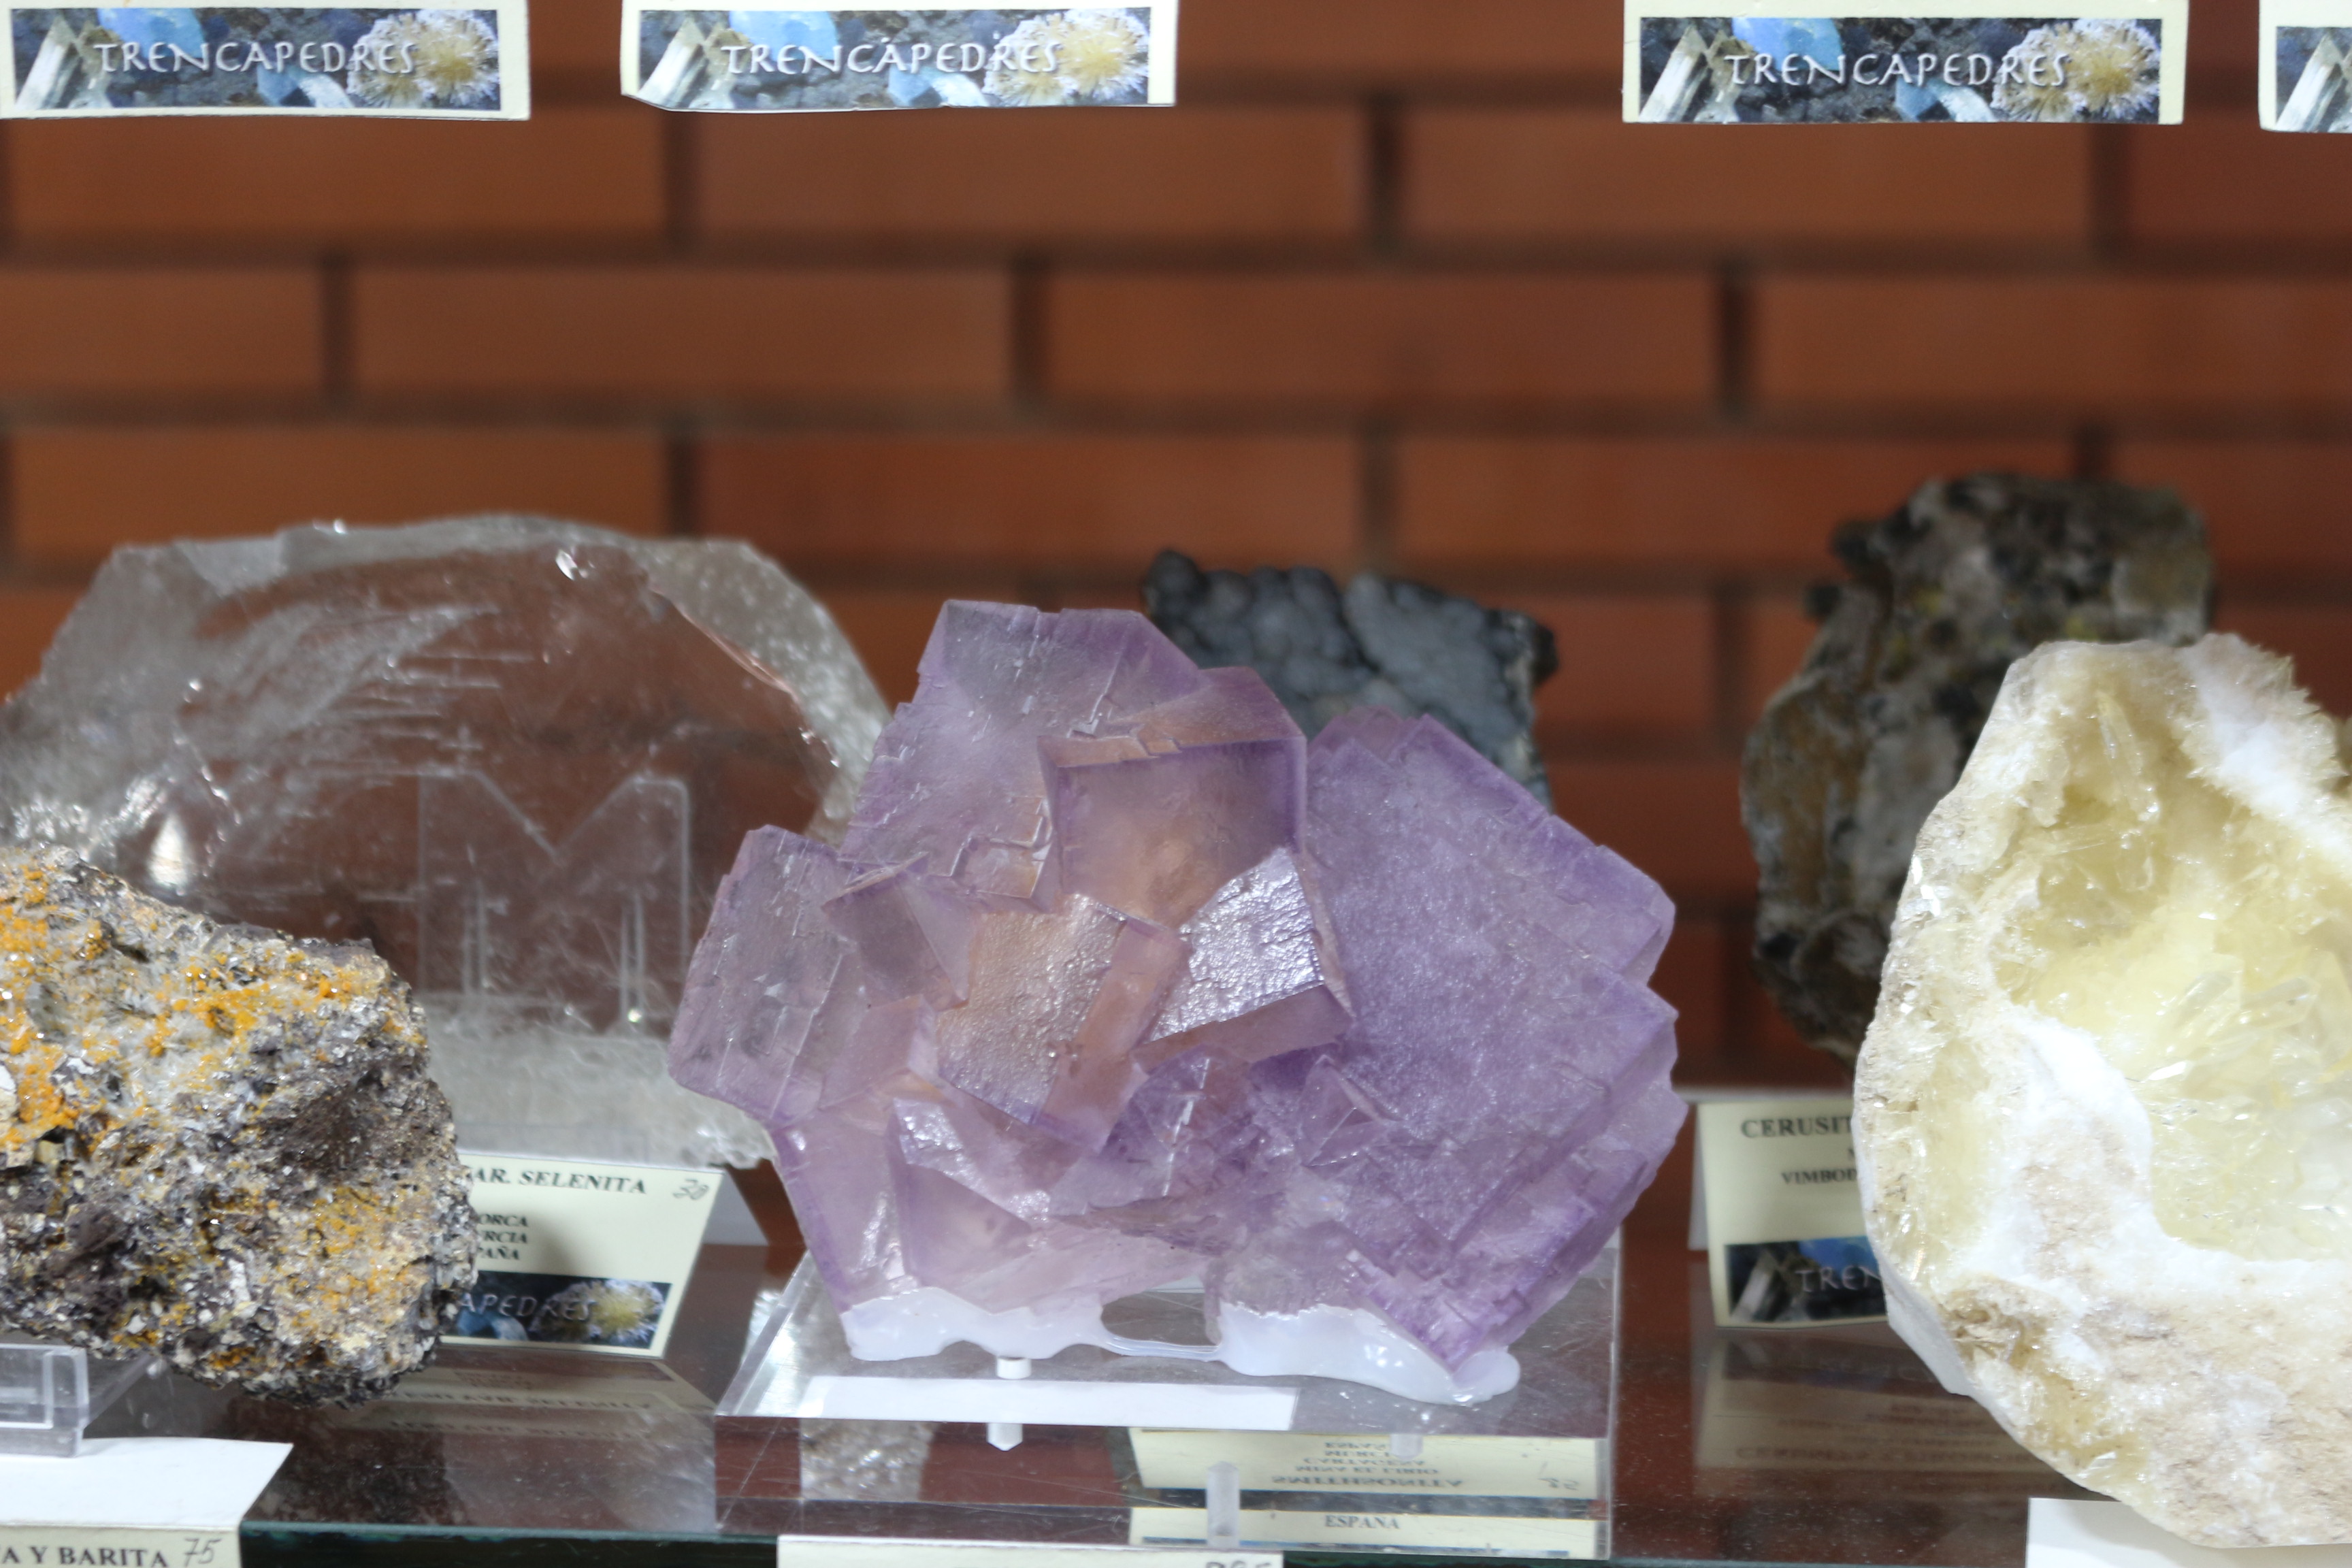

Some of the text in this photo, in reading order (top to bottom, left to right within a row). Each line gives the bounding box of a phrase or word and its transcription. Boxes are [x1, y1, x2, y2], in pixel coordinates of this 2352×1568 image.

[93, 39, 414, 75] TRENCAPEDRES
[720, 39, 1060, 74] TRENCAPEDRES
[1724, 52, 2070, 87] TRENCAPEDRES
[1741, 1116, 1852, 1138] CERUSIT
[467, 1166, 646, 1195] AR. SELENITA
[1781, 1169, 1858, 1186] VIMBOD
[477, 1213, 529, 1227] ORCA
[478, 1230, 528, 1244] RCIA
[29, 1546, 47, 1564] Y
[58, 1547, 170, 1567] BARITA
[183, 1537, 222, 1568] 75
